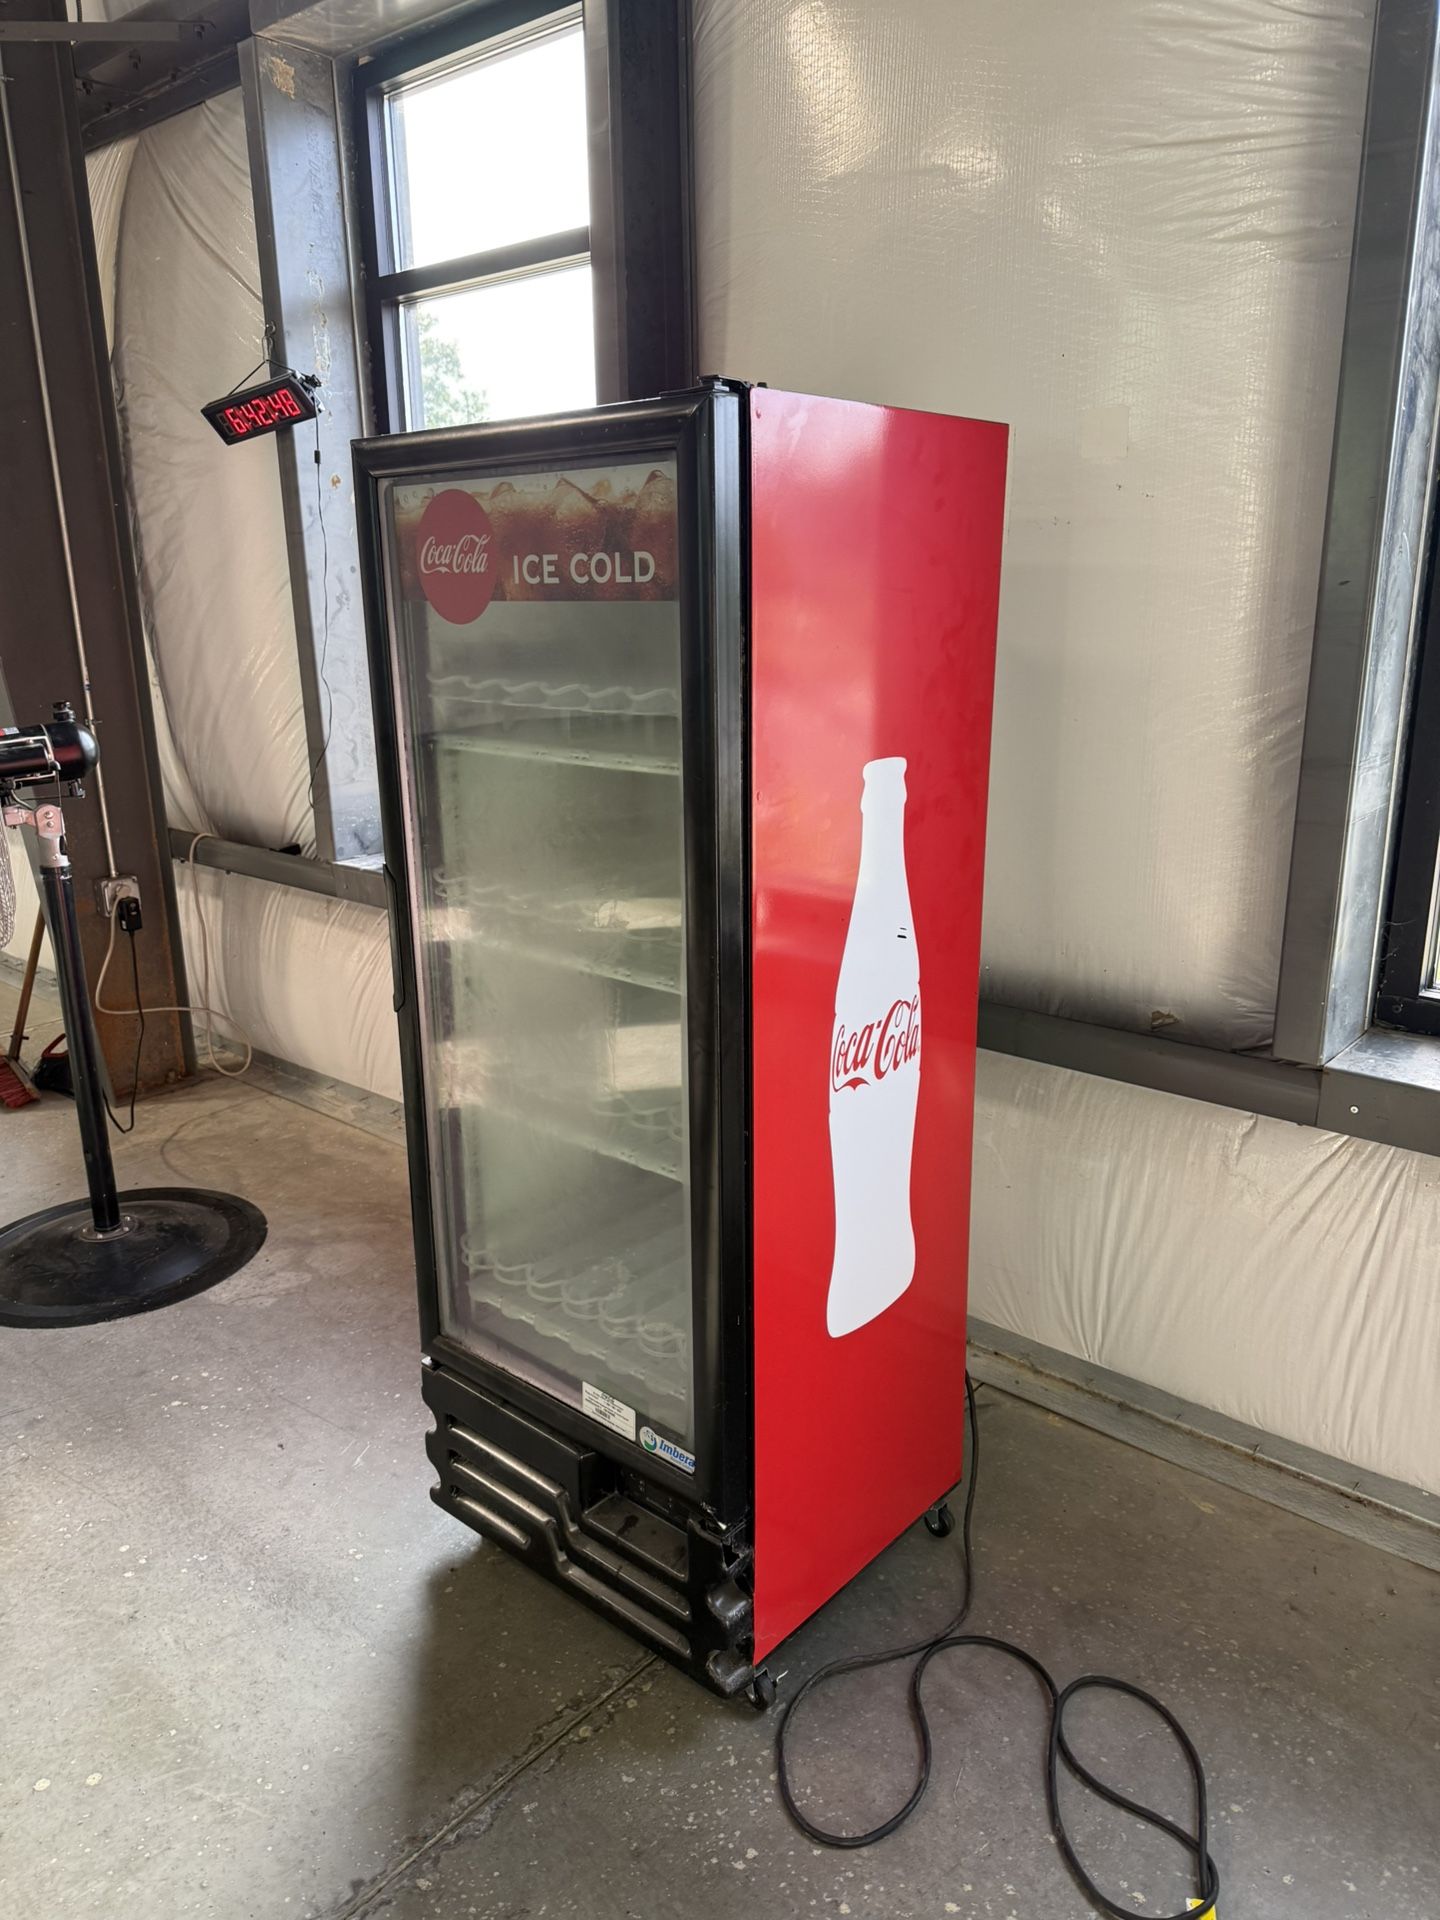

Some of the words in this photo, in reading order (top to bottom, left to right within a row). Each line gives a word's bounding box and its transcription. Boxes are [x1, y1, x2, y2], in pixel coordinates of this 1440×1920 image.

[513, 554, 560, 585] ICE
[569, 551, 656, 584] COLD
[659, 1440, 696, 1468] Imbera
